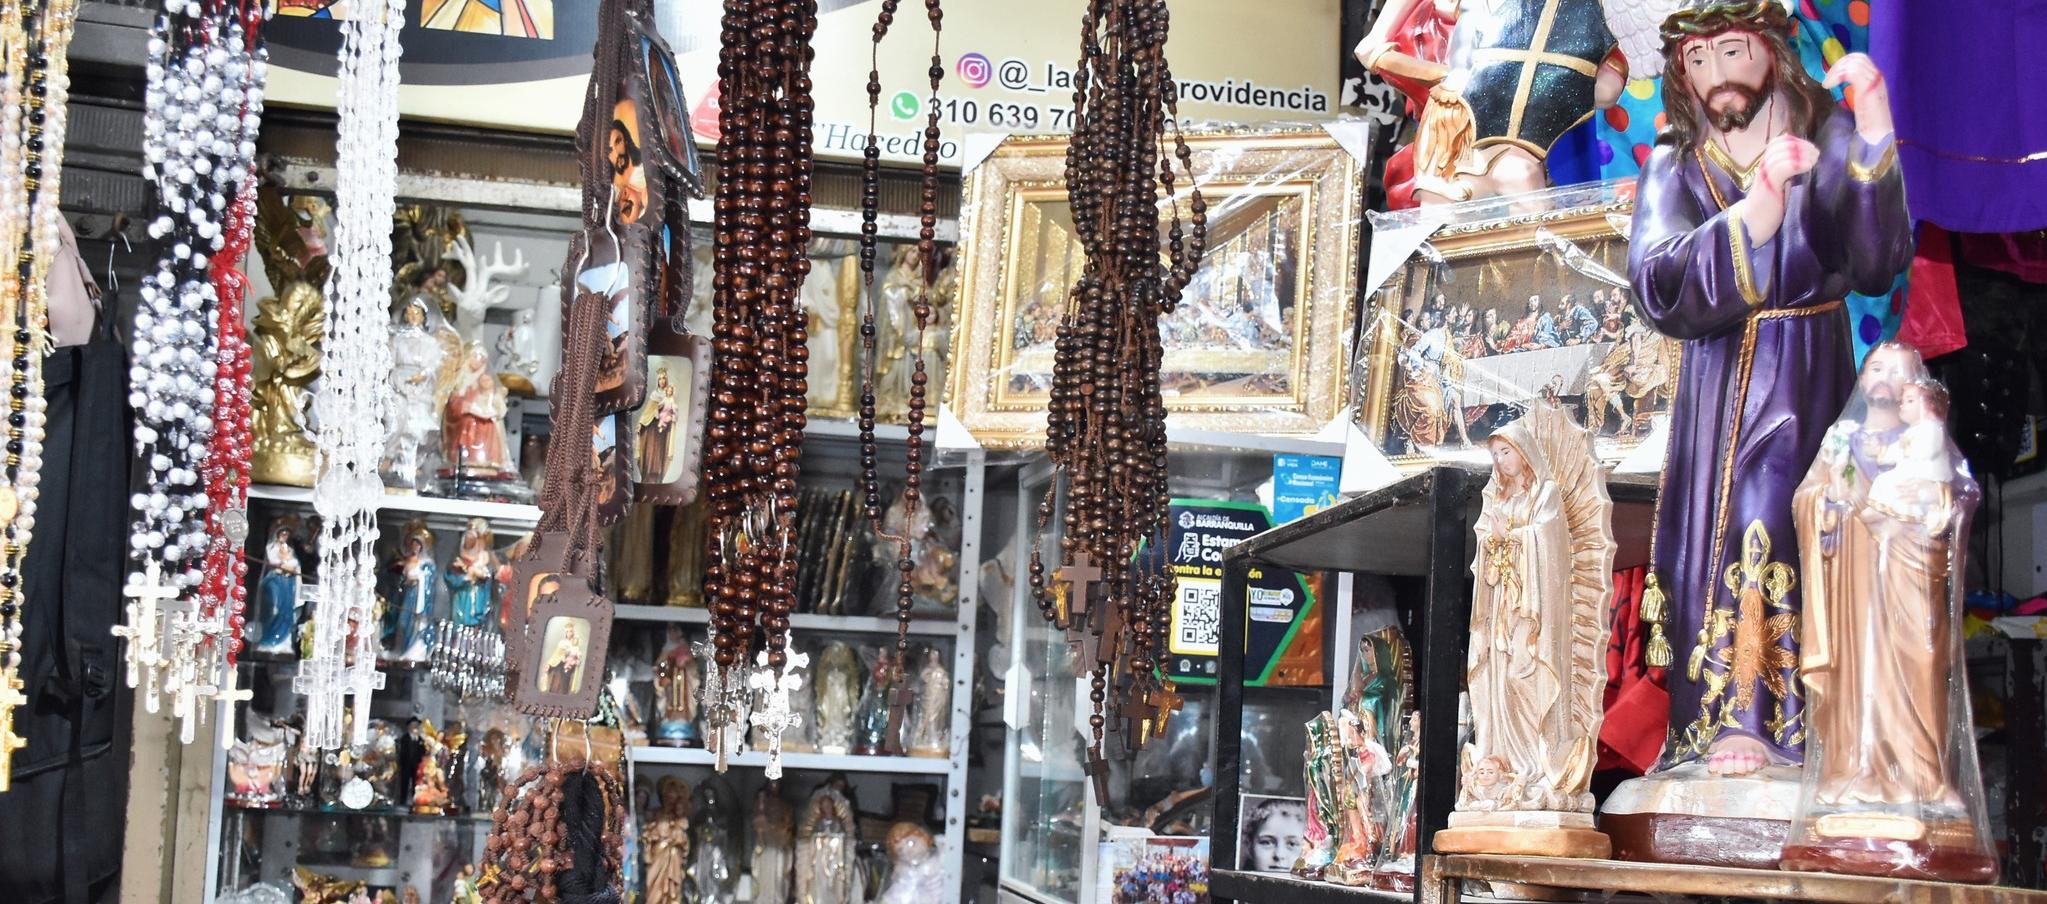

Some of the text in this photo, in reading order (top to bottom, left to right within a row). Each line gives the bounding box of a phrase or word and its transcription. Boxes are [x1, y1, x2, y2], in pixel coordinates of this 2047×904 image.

[928, 98, 977, 124] 310
[988, 103, 1038, 130] 639
[1195, 519, 1255, 531] BARRANQUILLA
[1171, 563, 1200, 575] ontra
[1202, 564, 1213, 576] la
